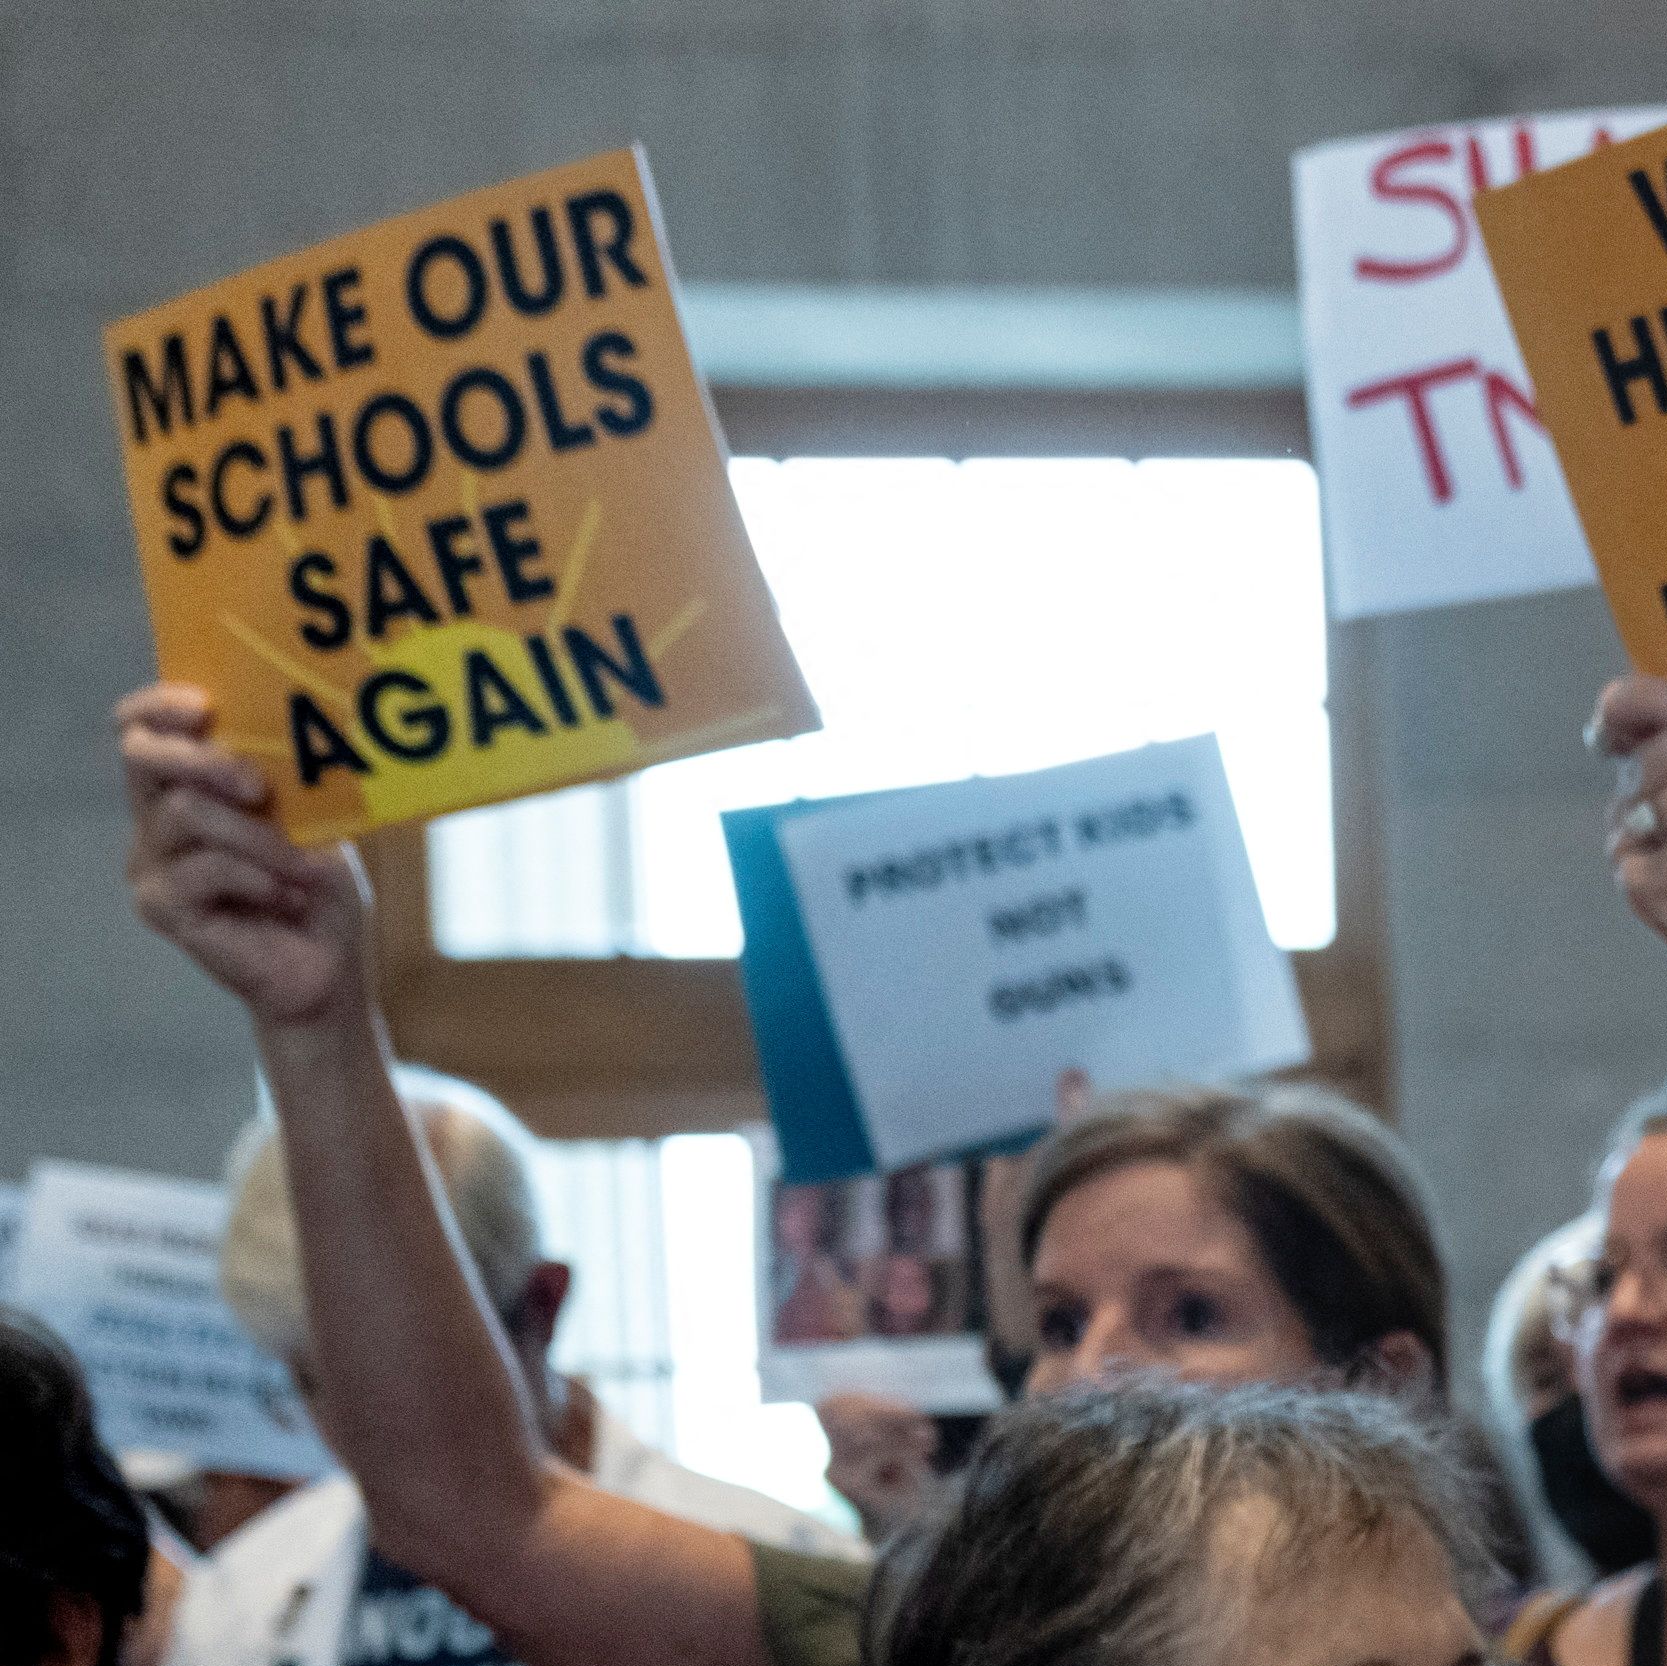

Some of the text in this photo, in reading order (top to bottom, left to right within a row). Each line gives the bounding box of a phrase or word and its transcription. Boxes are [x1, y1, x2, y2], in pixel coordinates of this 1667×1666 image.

[123, 188, 648, 444] MAKE OUR
[161, 331, 655, 560] SCHOOLS
[288, 500, 556, 651] SAFE
[287, 613, 666, 787] AGAIN
[845, 792, 1197, 908] PROTECT KIDS
[989, 887, 1088, 942] NOT
[991, 956, 1133, 1022] GUNS
